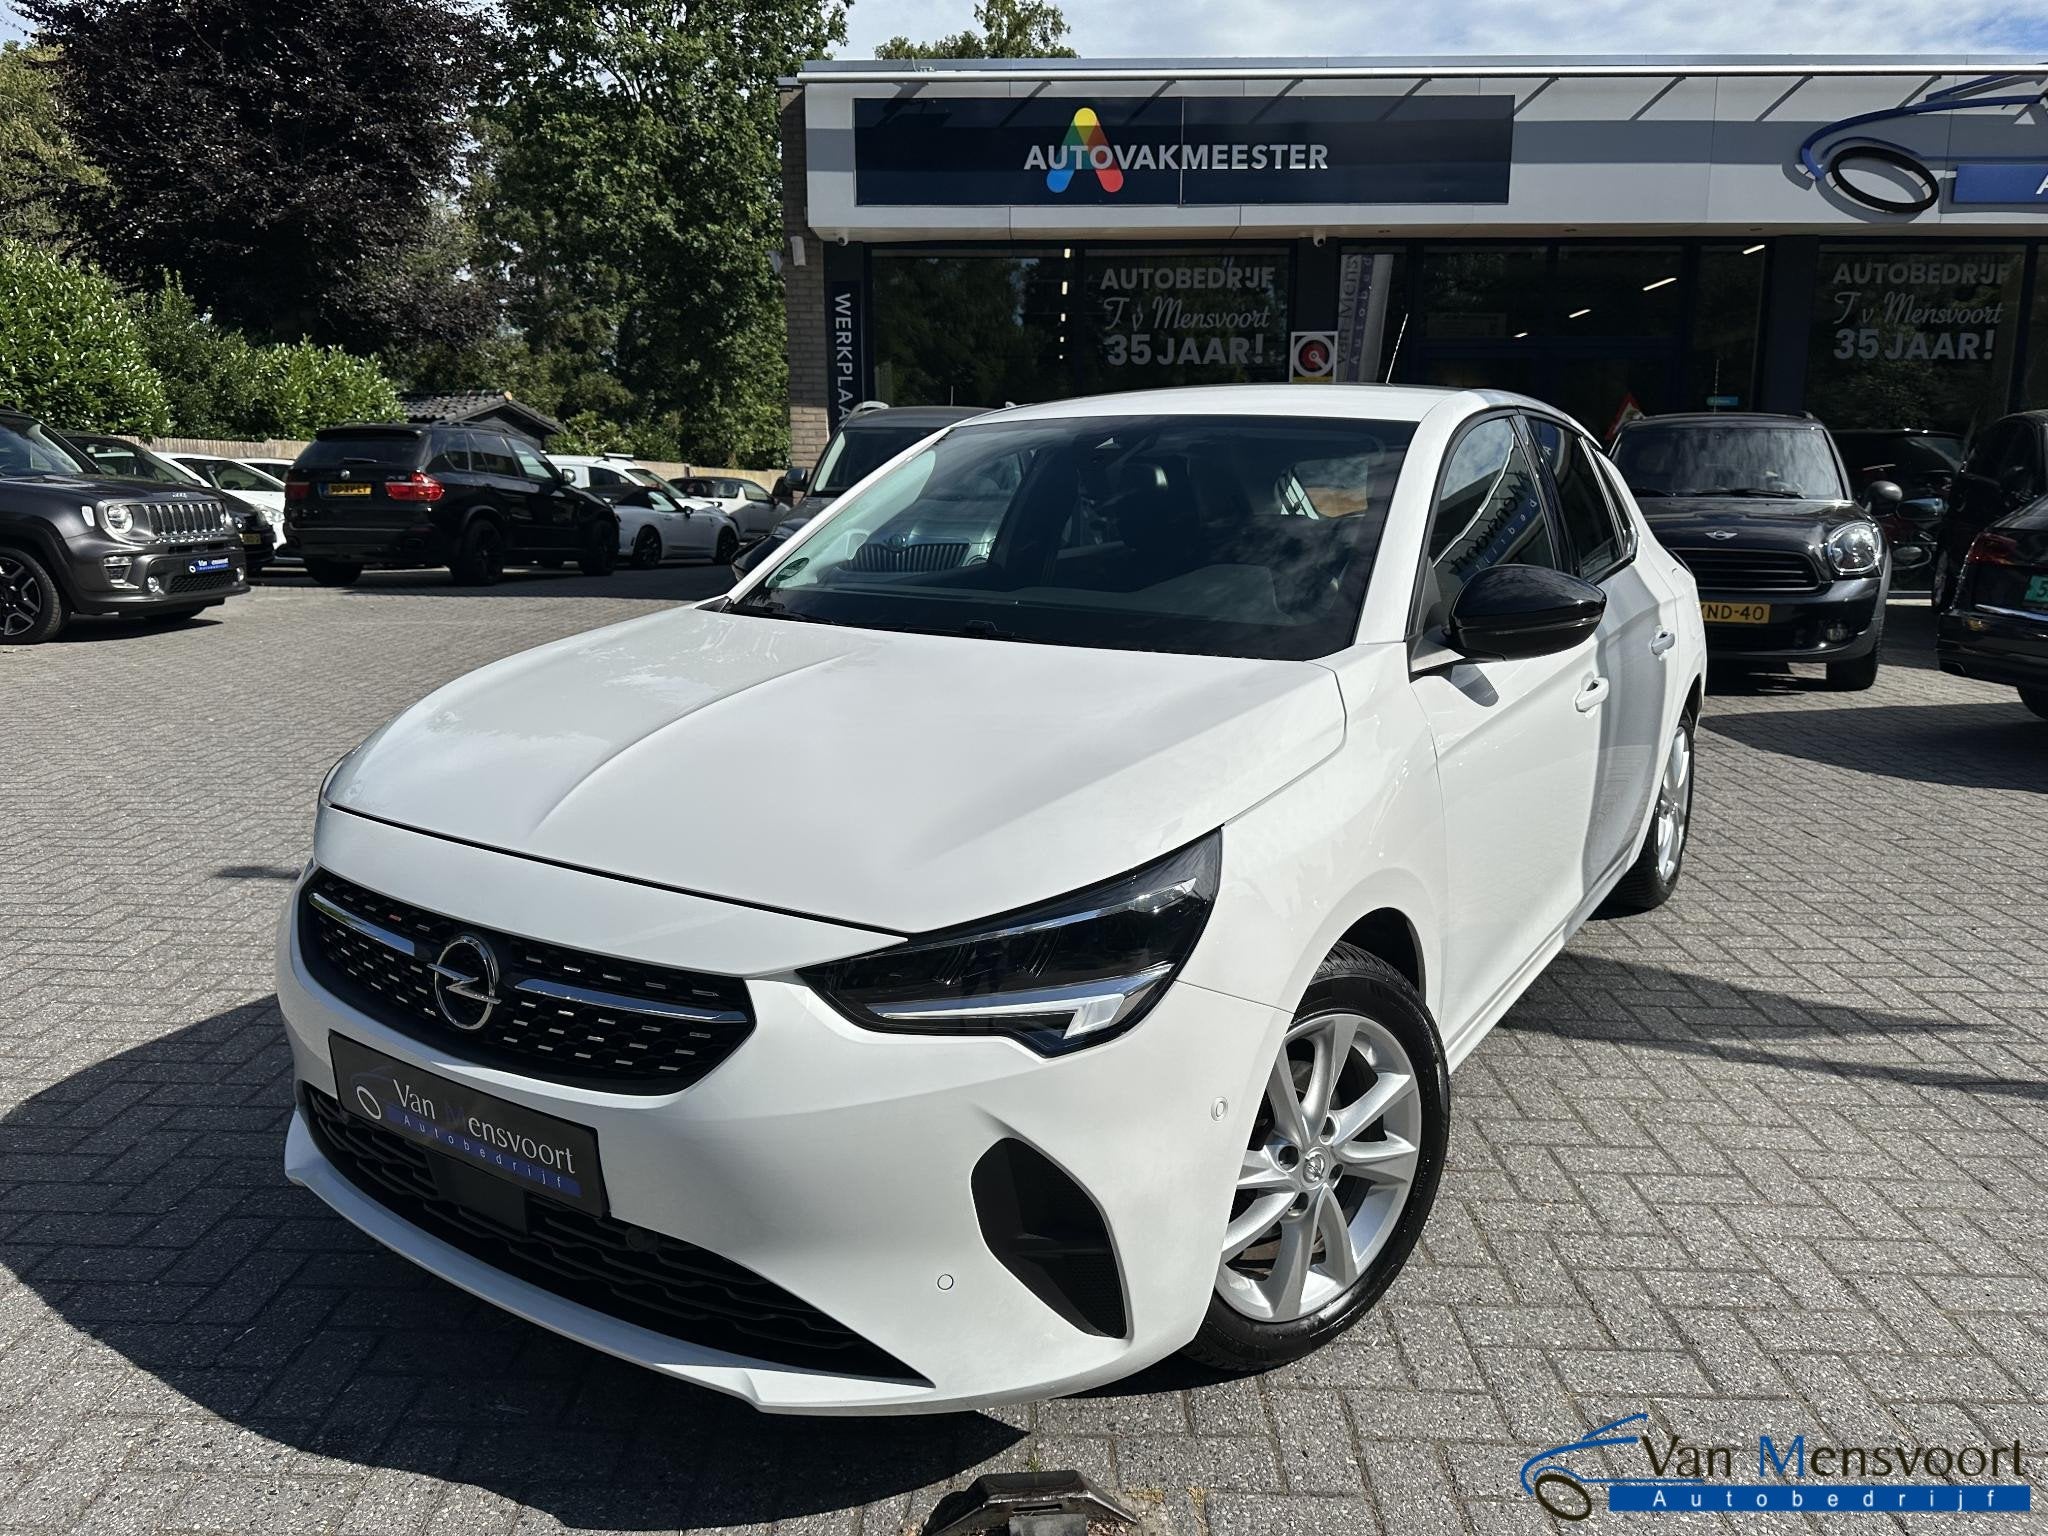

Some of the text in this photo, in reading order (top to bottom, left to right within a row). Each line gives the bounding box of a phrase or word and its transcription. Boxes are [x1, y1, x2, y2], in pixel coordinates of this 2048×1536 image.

[1023, 144, 1329, 170] AUTOVAKMEESTER
[1100, 267, 1276, 290] AUTOBEDRIJF
[1833, 263, 2012, 285] AUTOBEDRIJF
[1152, 295, 1271, 329] Mensvoort
[1862, 307, 1874, 322] v
[1884, 291, 2004, 324] Mensvoort
[1106, 333, 1264, 366] 35 JAAR!
[1833, 328, 1995, 360] 35 JAAR!
[393, 1079, 576, 1175] Van Mensvoort
[403, 1114, 562, 1189] Autobedrijf
